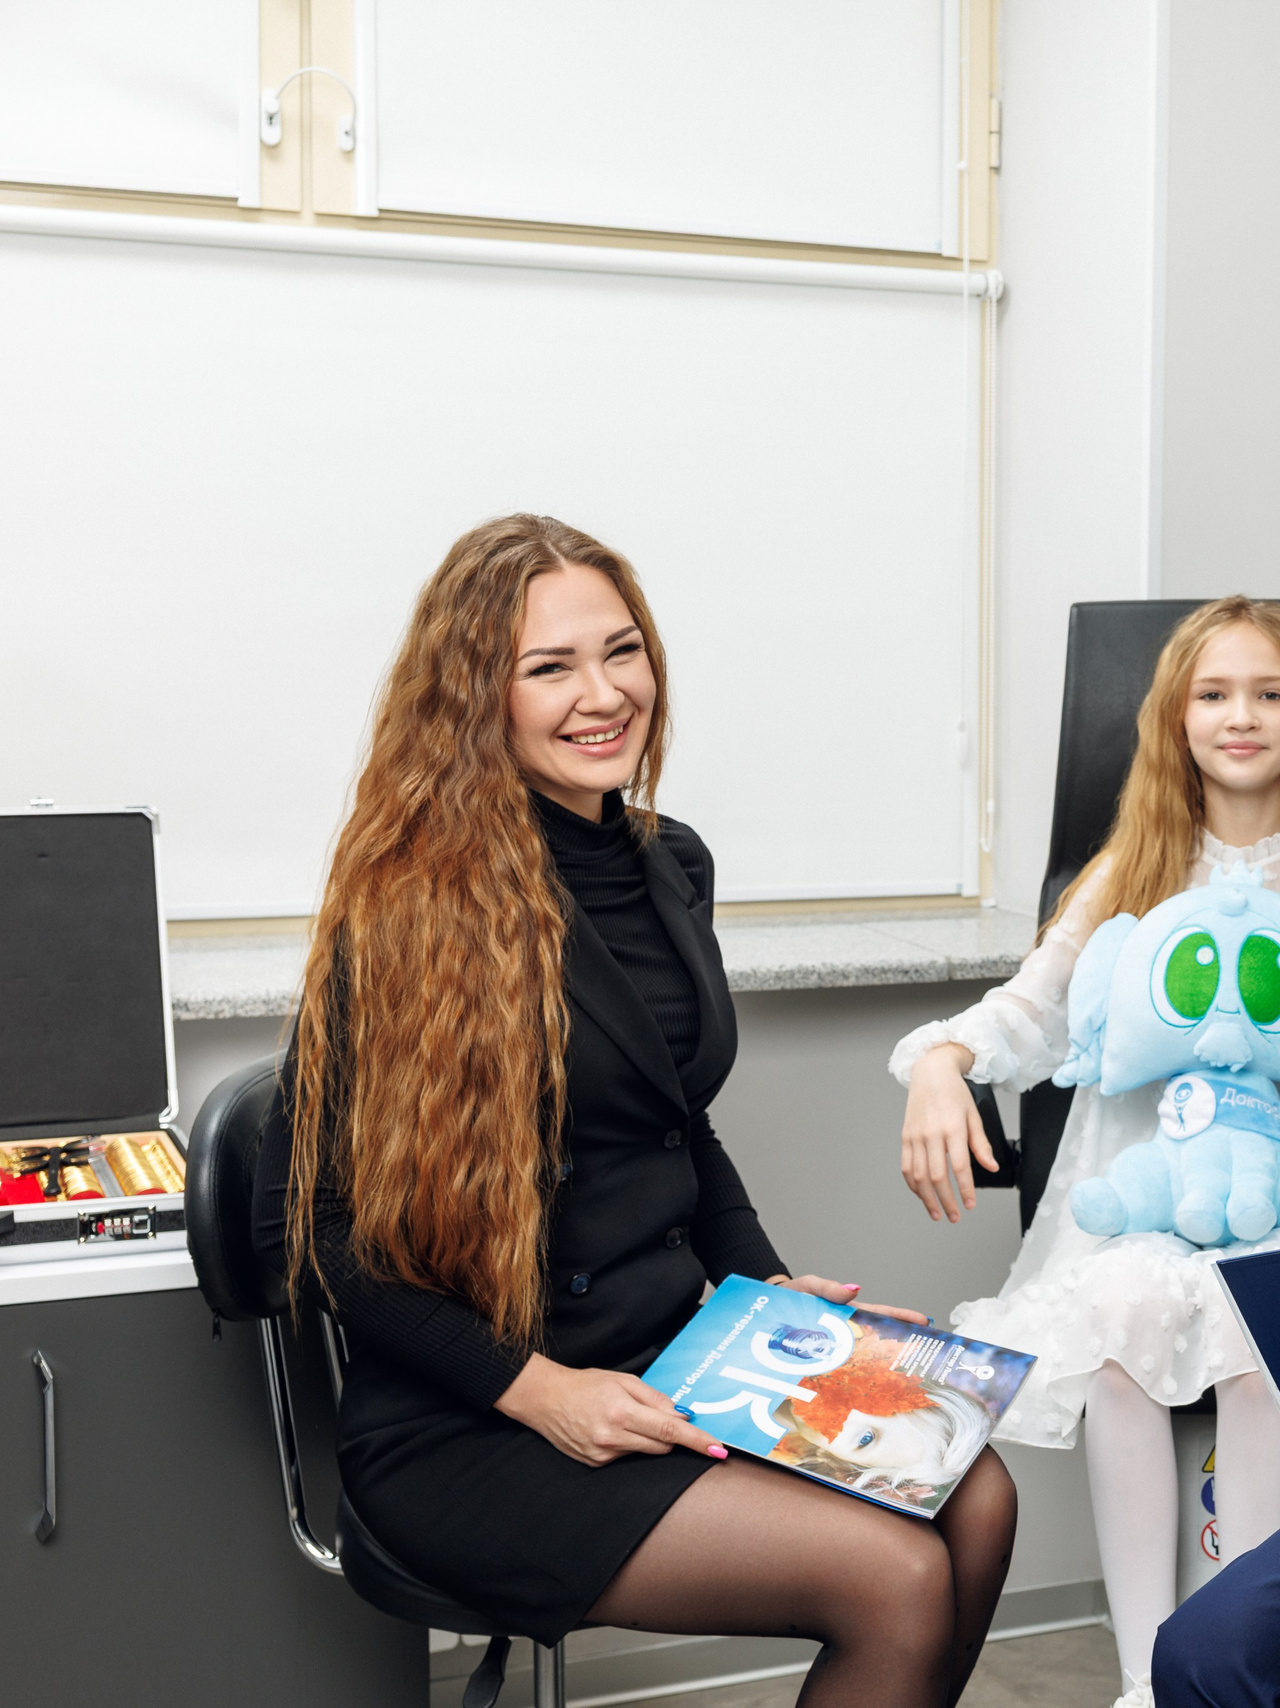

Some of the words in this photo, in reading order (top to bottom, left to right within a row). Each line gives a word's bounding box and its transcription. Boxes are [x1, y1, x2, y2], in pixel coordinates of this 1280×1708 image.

[717, 1295, 769, 1351] ОК-терапия
[685, 1350, 723, 1385] Доктор
[671, 1385, 693, 1404] Лин
